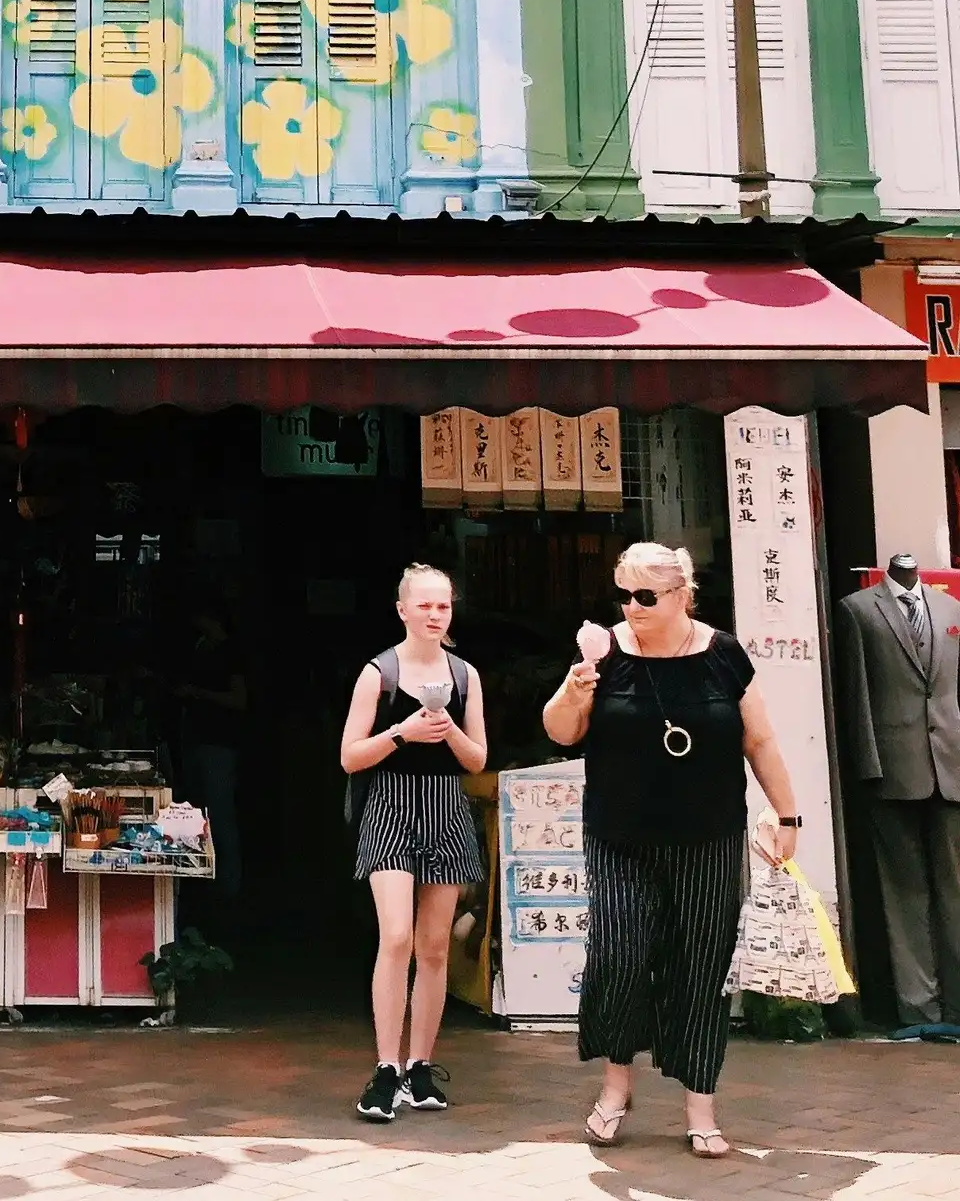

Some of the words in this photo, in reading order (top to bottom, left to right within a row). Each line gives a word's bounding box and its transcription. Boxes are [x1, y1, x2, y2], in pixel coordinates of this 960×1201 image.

[925, 294, 960, 357] R
[735, 458, 757, 523] 阿米莉亚
